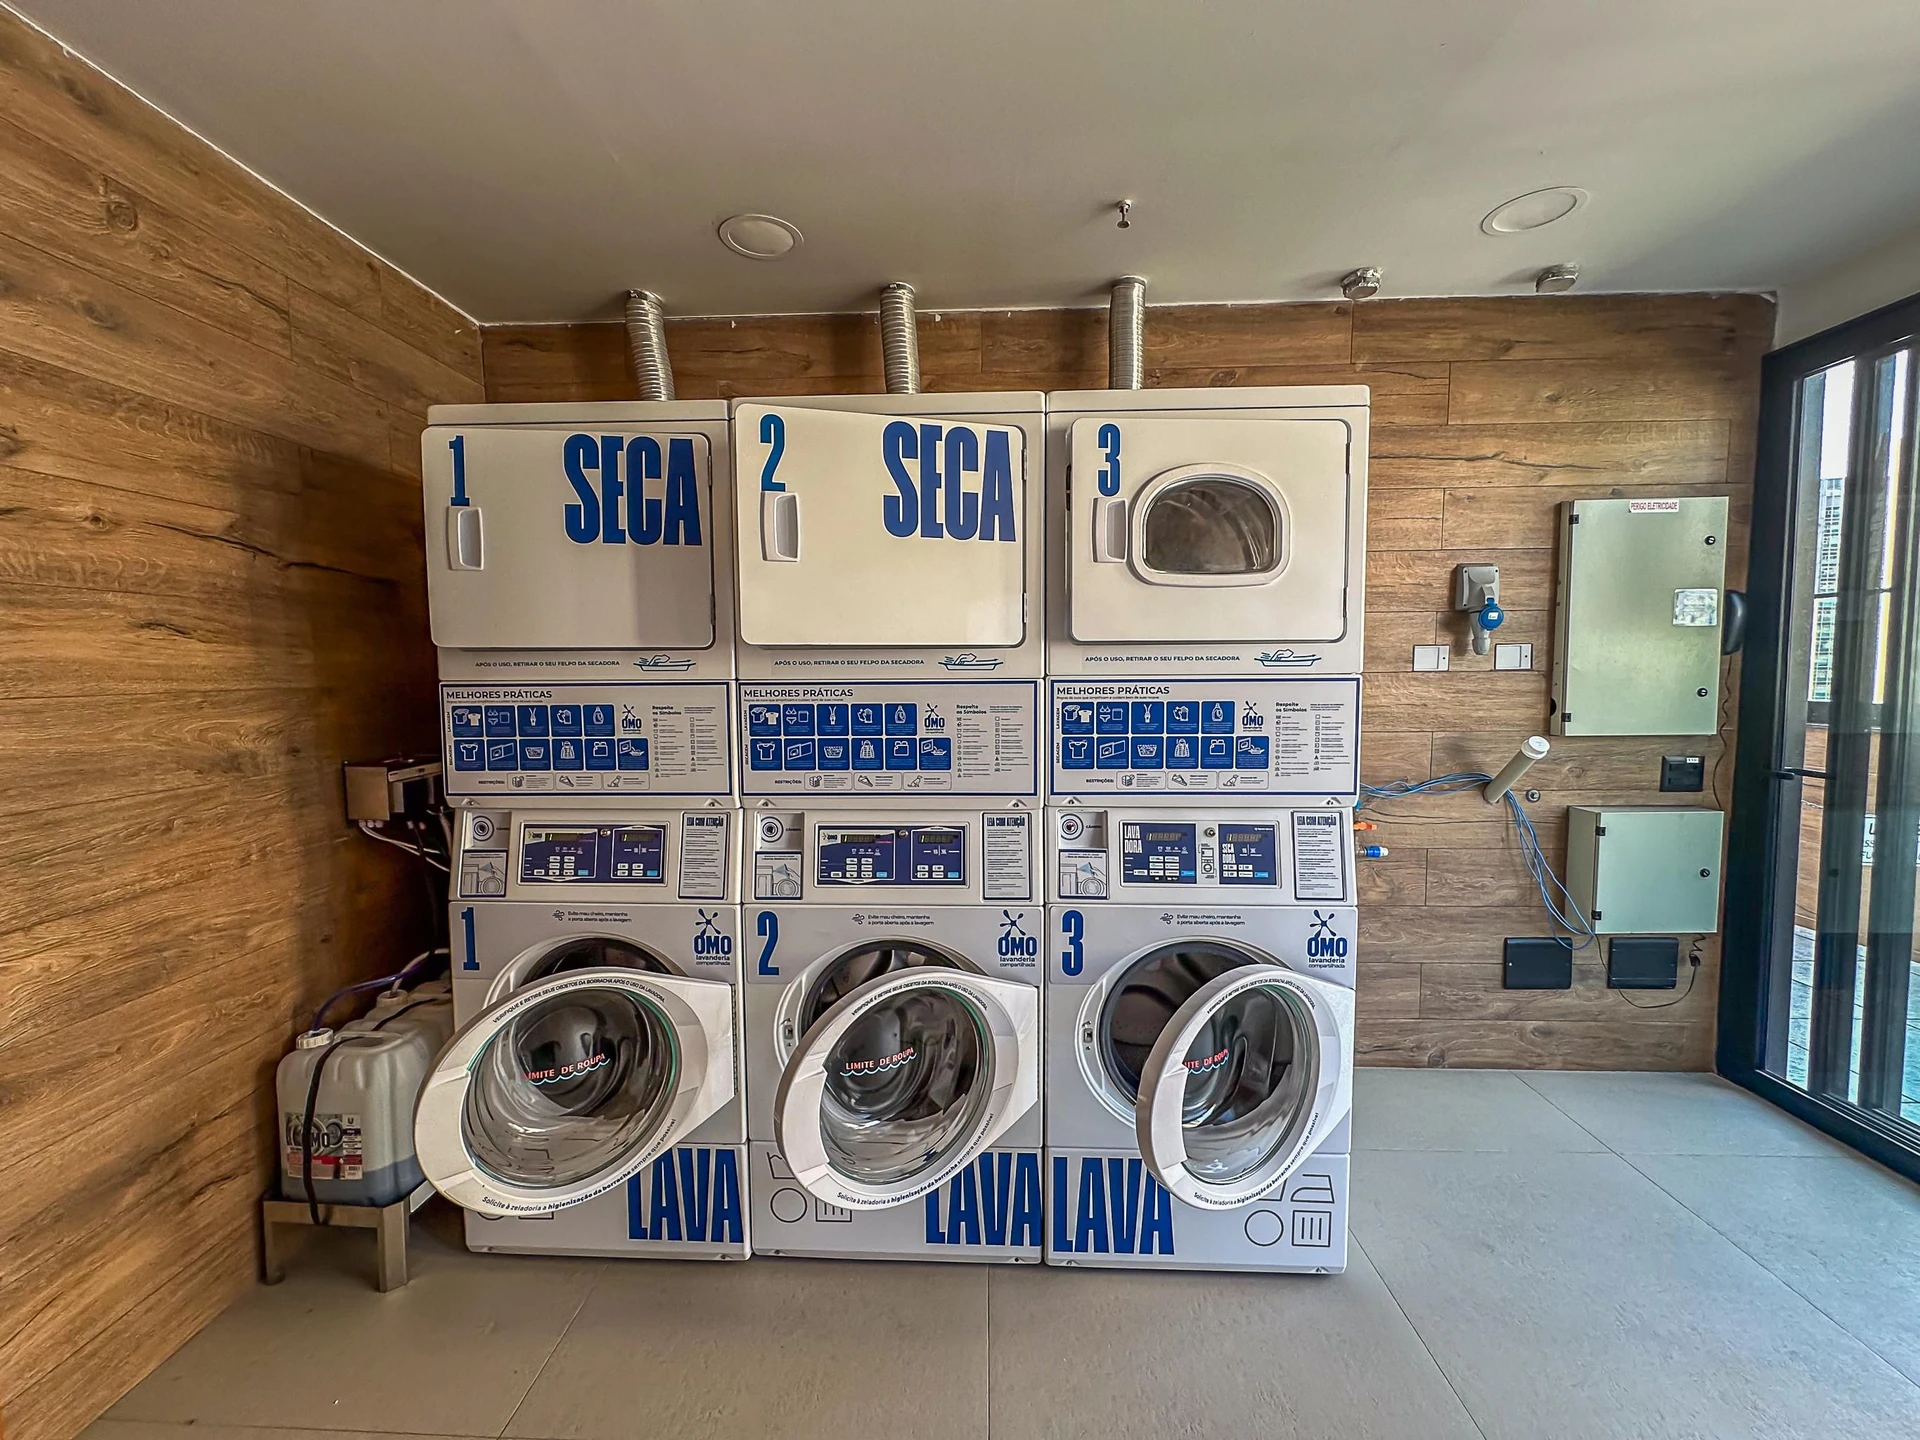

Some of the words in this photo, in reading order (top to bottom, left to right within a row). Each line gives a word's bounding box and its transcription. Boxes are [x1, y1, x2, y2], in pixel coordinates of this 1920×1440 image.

[448, 435, 470, 506] 1
[760, 414, 786, 492] 2
[1100, 424, 1120, 496] 3
[564, 434, 702, 545] SECA
[883, 422, 1016, 541] SECA
[504, 689, 552, 698] PRÁTICAS
[803, 688, 853, 696] PRÁTICAS
[1118, 685, 1170, 694] PRÁTICAS
[925, 718, 945, 728] OMO
[1242, 715, 1263, 726] OMO
[1125, 825, 1140, 838] LAVA
[1125, 840, 1142, 853] DORA
[462, 907, 479, 970] 1
[694, 935, 731, 954] OMO
[757, 911, 779, 975] 2
[998, 937, 1037, 956] OMO
[1062, 910, 1083, 976] 3
[1308, 937, 1347, 957] OMO
[493, 1004, 519, 1023] VERIFIQUE
[524, 992, 541, 1004] RETIRE
[644, 987, 665, 1003] LAVADORA
[562, 1065, 574, 1074] DE
[578, 1053, 605, 1069] ROUPA
[846, 1061, 874, 1070] LIMITE
[482, 1196, 506, 1211] Solicite
[548, 1193, 593, 1210] higienização
[602, 1170, 631, 1191] borracha
[631, 1152, 652, 1172] sempre
[651, 1141, 662, 1153] que
[661, 1119, 676, 1142] possível
[838, 1192, 856, 1204] Solicite
[892, 1184, 927, 1203] higienização
[934, 1164, 958, 1184] borracha
[958, 1146, 974, 1164] sempre
[973, 1135, 982, 1147] que
[981, 1113, 994, 1136] possível
[628, 1148, 744, 1243] LAVA
[926, 1152, 1042, 1246] LAVA
[1053, 1157, 1174, 1254] LAVA
